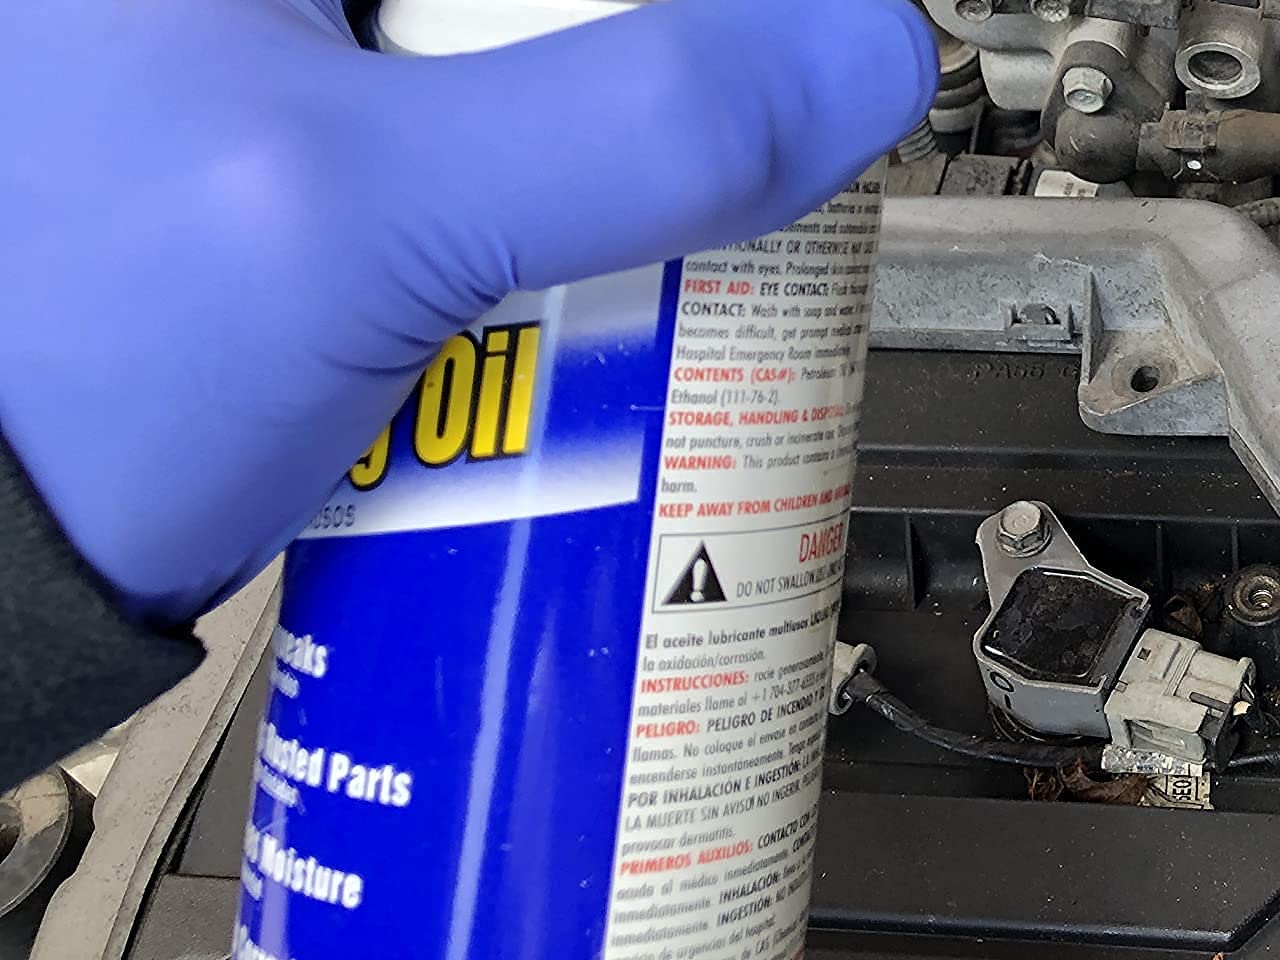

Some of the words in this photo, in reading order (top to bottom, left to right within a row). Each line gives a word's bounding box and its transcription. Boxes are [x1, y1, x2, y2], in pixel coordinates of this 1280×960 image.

[786, 240, 801, 254] OR
[685, 260, 728, 273] contact
[732, 261, 754, 274] with
[786, 262, 829, 279] Prolonged
[684, 279, 721, 294] FIRST
[726, 281, 754, 296] AID:
[759, 282, 779, 296] EYE
[784, 282, 829, 297] CONTACT:
[682, 301, 746, 317] CONTACT:
[751, 304, 778, 318] Wash
[783, 304, 801, 317] with
[679, 324, 730, 339] becomes
[782, 327, 797, 342] get
[676, 345, 726, 363] Hospital
[730, 346, 784, 363] Emergency
[788, 346, 812, 360] Room
[673, 367, 745, 382] CONTENTS
[414, 321, 541, 468] Oil
[671, 390, 718, 405] Ethanol
[668, 411, 734, 427] STORAGE,
[739, 409, 799, 426] HANDLING
[802, 409, 808, 423] &
[666, 435, 685, 448] not
[690, 435, 742, 452] puncture,
[746, 433, 772, 448] crush
[775, 435, 785, 446] or
[664, 455, 738, 470] WARNING:
[743, 455, 763, 469] This
[766, 451, 800, 470] product
[661, 478, 697, 493] harm.
[659, 503, 694, 518] KEEP
[697, 502, 735, 517] AWAY
[738, 499, 771, 514] FROM
[774, 492, 817, 512] CHILDREN
[737, 580, 752, 598] DO
[755, 578, 775, 595] NOT
[646, 634, 658, 649] El
[663, 633, 703, 649] aceite
[708, 628, 766, 647] lubricante
[768, 618, 808, 637] multiusos
[642, 656, 655, 672] la
[641, 670, 749, 694] INSTRUCCIONES:
[638, 698, 702, 717] materiales
[705, 692, 735, 712] llame
[738, 690, 748, 707] al
[636, 719, 700, 739] PELIGRO:
[707, 712, 756, 733] PELIGRO
[760, 707, 773, 723] DE
[632, 745, 677, 763] llamas.
[683, 743, 700, 759] No
[704, 737, 744, 756] coloque
[748, 732, 756, 747] el
[759, 727, 786, 745] envase
[327, 751, 413, 808] Parts
[630, 765, 698, 785] encenderse
[627, 791, 658, 809] POR
[662, 778, 742, 805] INHALACIÓN
[745, 775, 752, 791] E
[625, 814, 642, 833] LA
[646, 808, 697, 830] MUERTE
[701, 804, 719, 823] SIN
[620, 854, 692, 877] PRIMEROS
[697, 839, 753, 866] AUXILIOS:
[758, 818, 799, 850] CONTACTO
[621, 835, 676, 857] provocar
[679, 828, 737, 850] dermatitis.
[259, 832, 363, 910] Moisture
